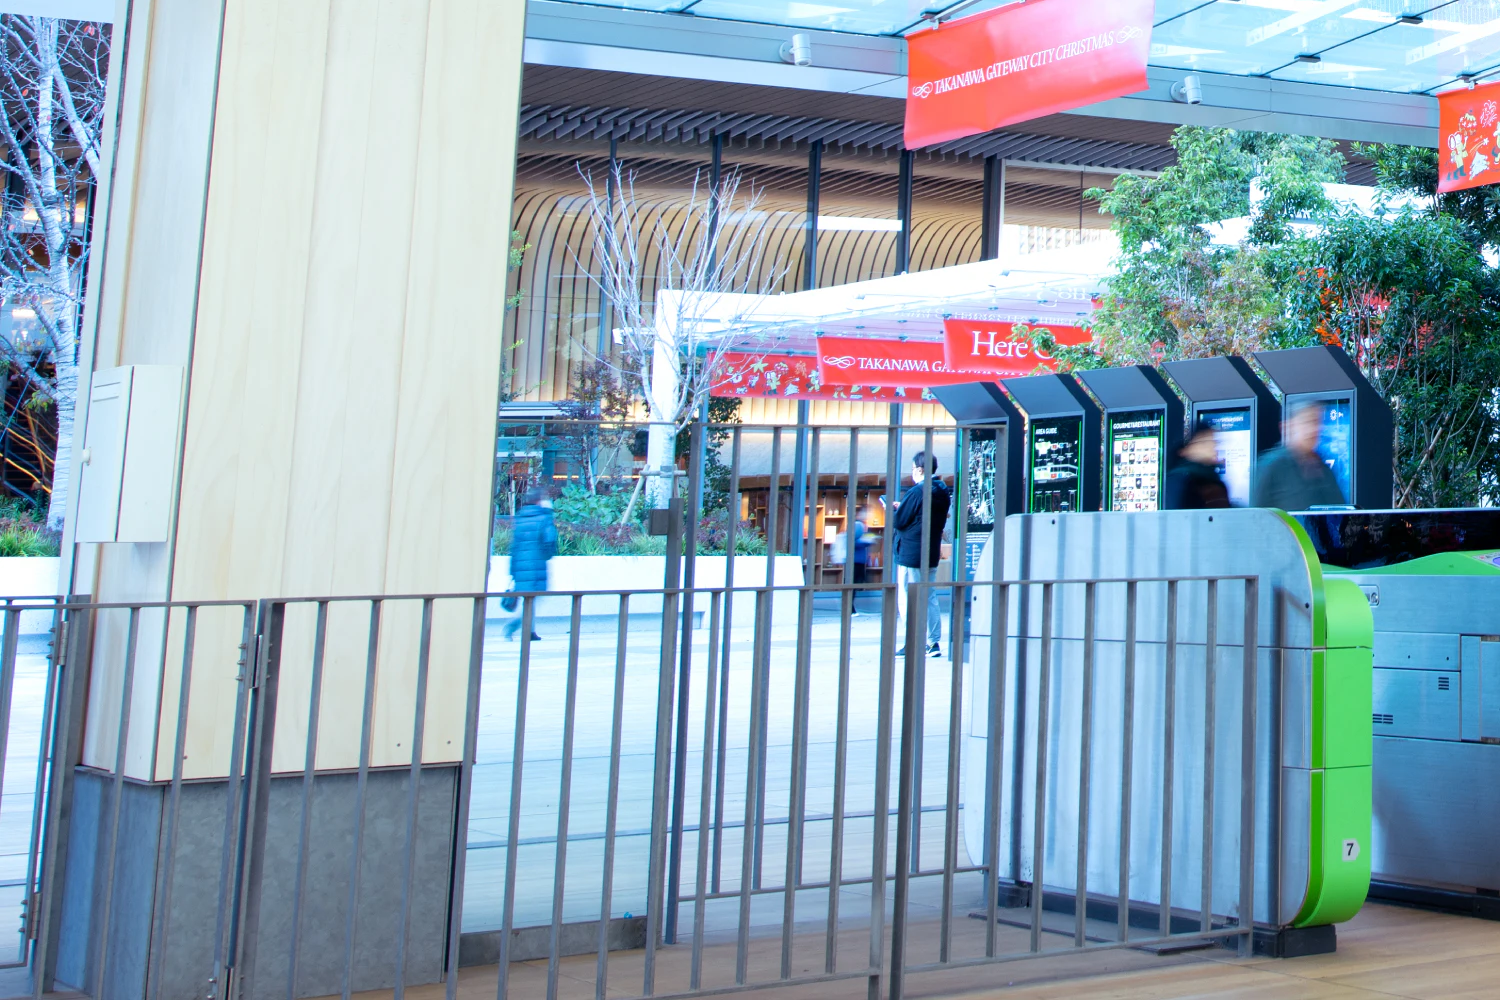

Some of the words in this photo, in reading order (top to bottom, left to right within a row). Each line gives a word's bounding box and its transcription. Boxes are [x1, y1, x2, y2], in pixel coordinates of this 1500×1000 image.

[934, 68, 985, 95] TAKANAWA
[986, 54, 1030, 80] GATEWAY
[1030, 48, 1055, 68] CITY
[1055, 31, 1114, 61] CHRISTMAS
[970, 330, 1028, 358] Here
[858, 357, 929, 372] TAKANAWA
[1035, 427, 1045, 435] AREA
[1045, 427, 1058, 435] GUIDE
[1346, 843, 1354, 857] 7
